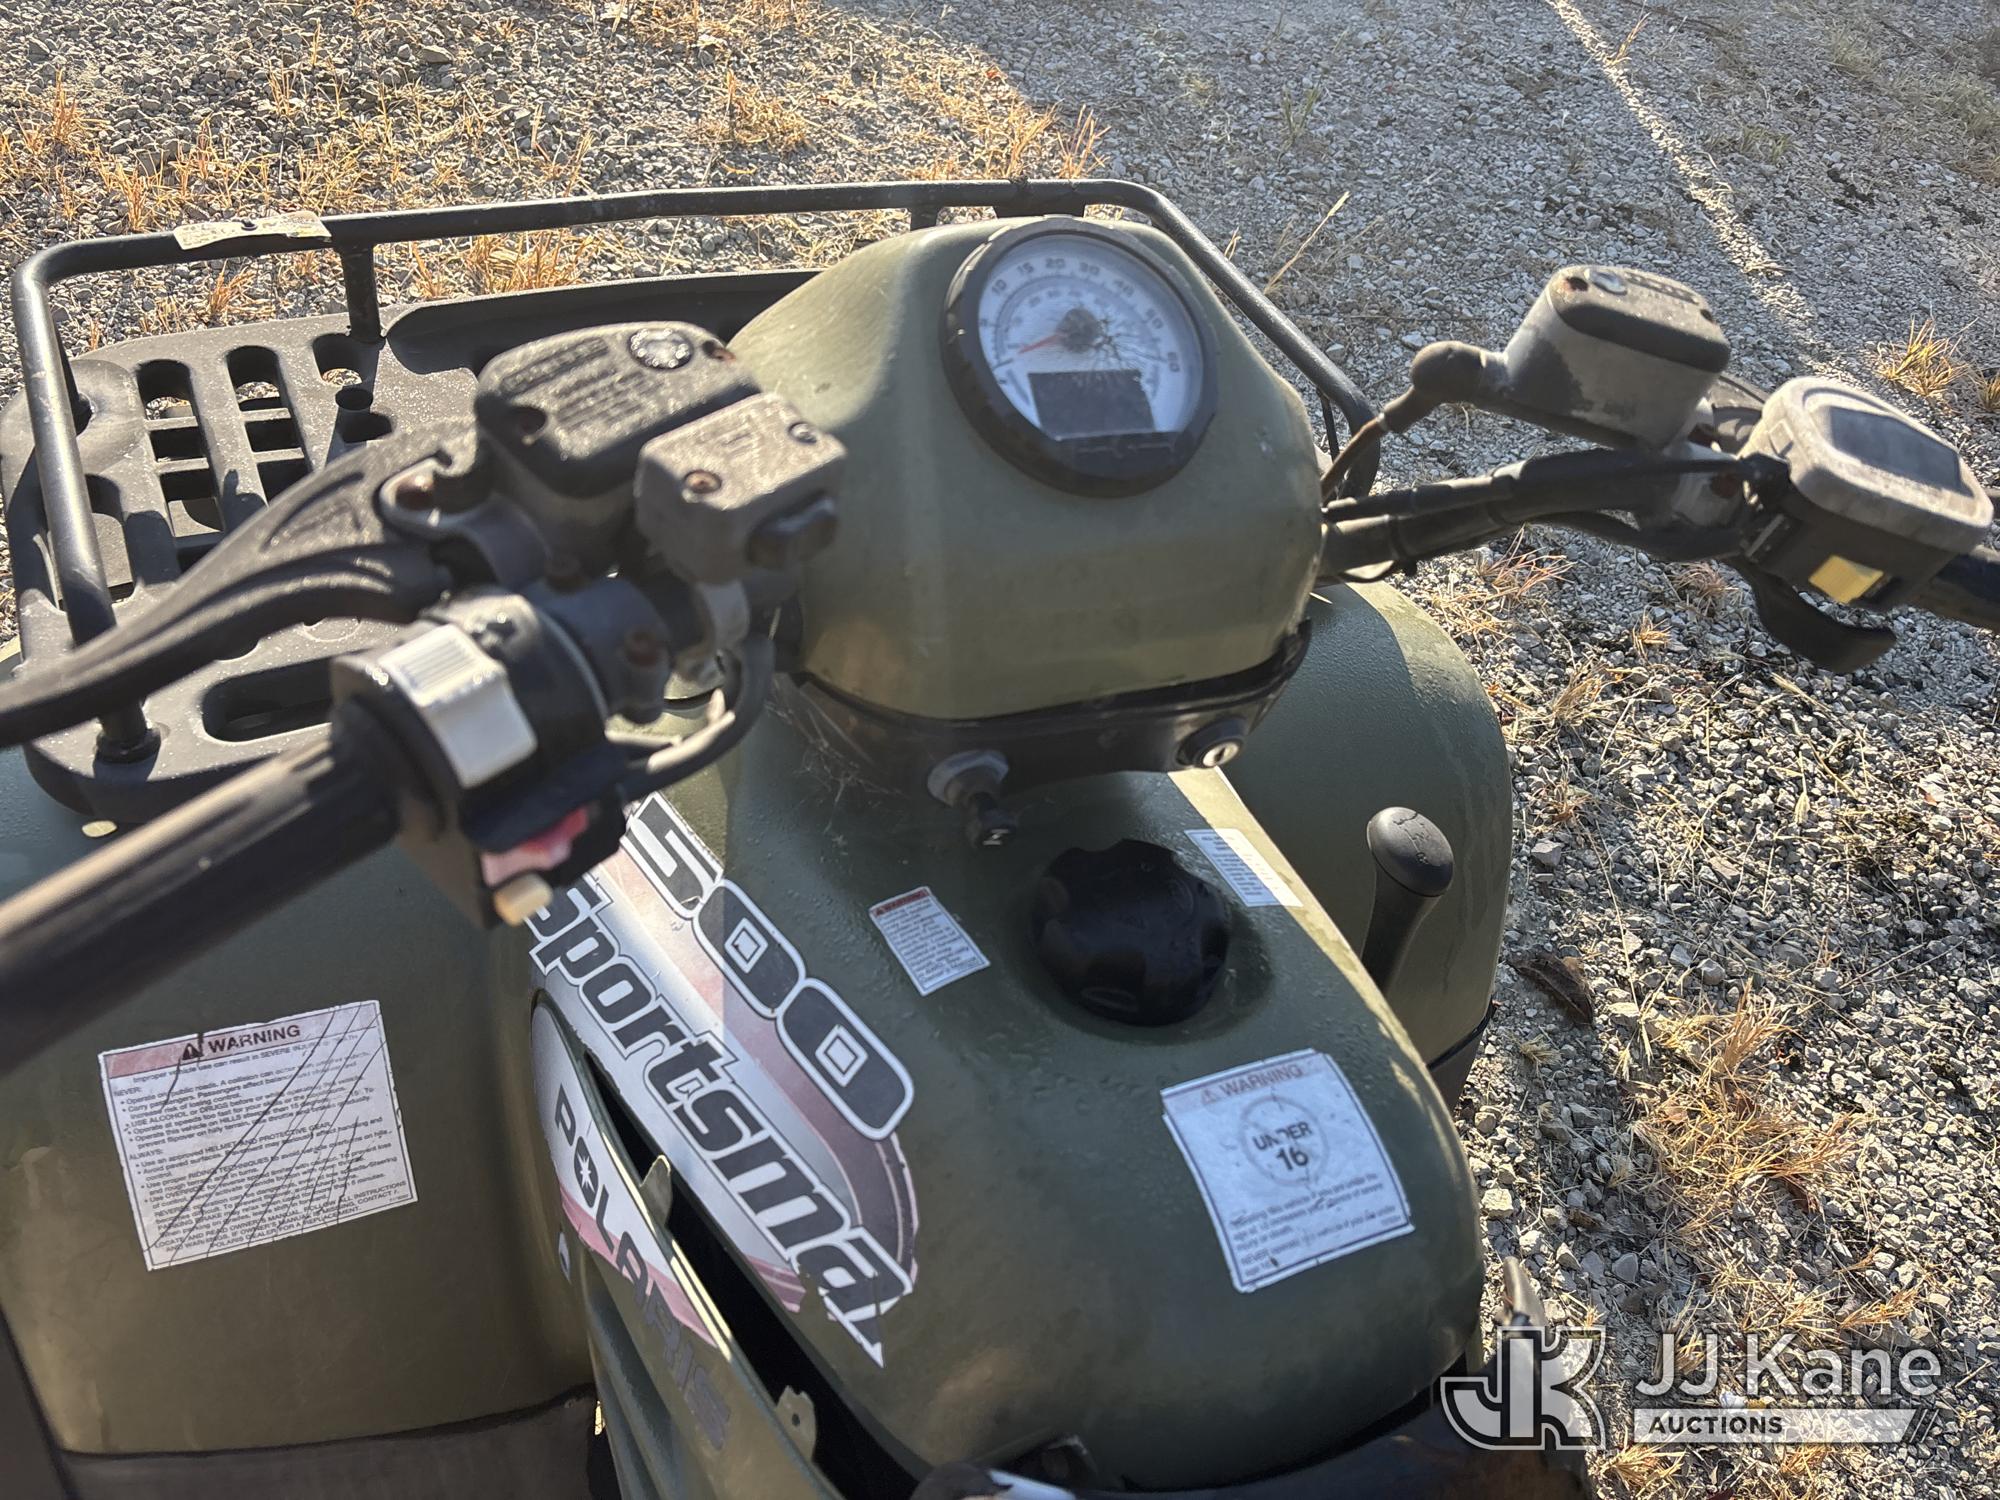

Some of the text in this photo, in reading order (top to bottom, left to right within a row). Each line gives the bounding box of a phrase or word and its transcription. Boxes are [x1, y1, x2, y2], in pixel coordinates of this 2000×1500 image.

[1017, 262, 1034, 274] 15
[1045, 258, 1066, 269] 20
[1079, 262, 1100, 275] 30
[991, 279, 1007, 294] 10
[1112, 279, 1135, 298] 40
[621, 792, 914, 1140] 500
[208, 1023, 300, 1054] WARNING
[1219, 1062, 1303, 1097] WARNING
[526, 869, 914, 1367] Sportsma
[1276, 1146, 1309, 1171] 16
[555, 1083, 730, 1450] POLARIS
